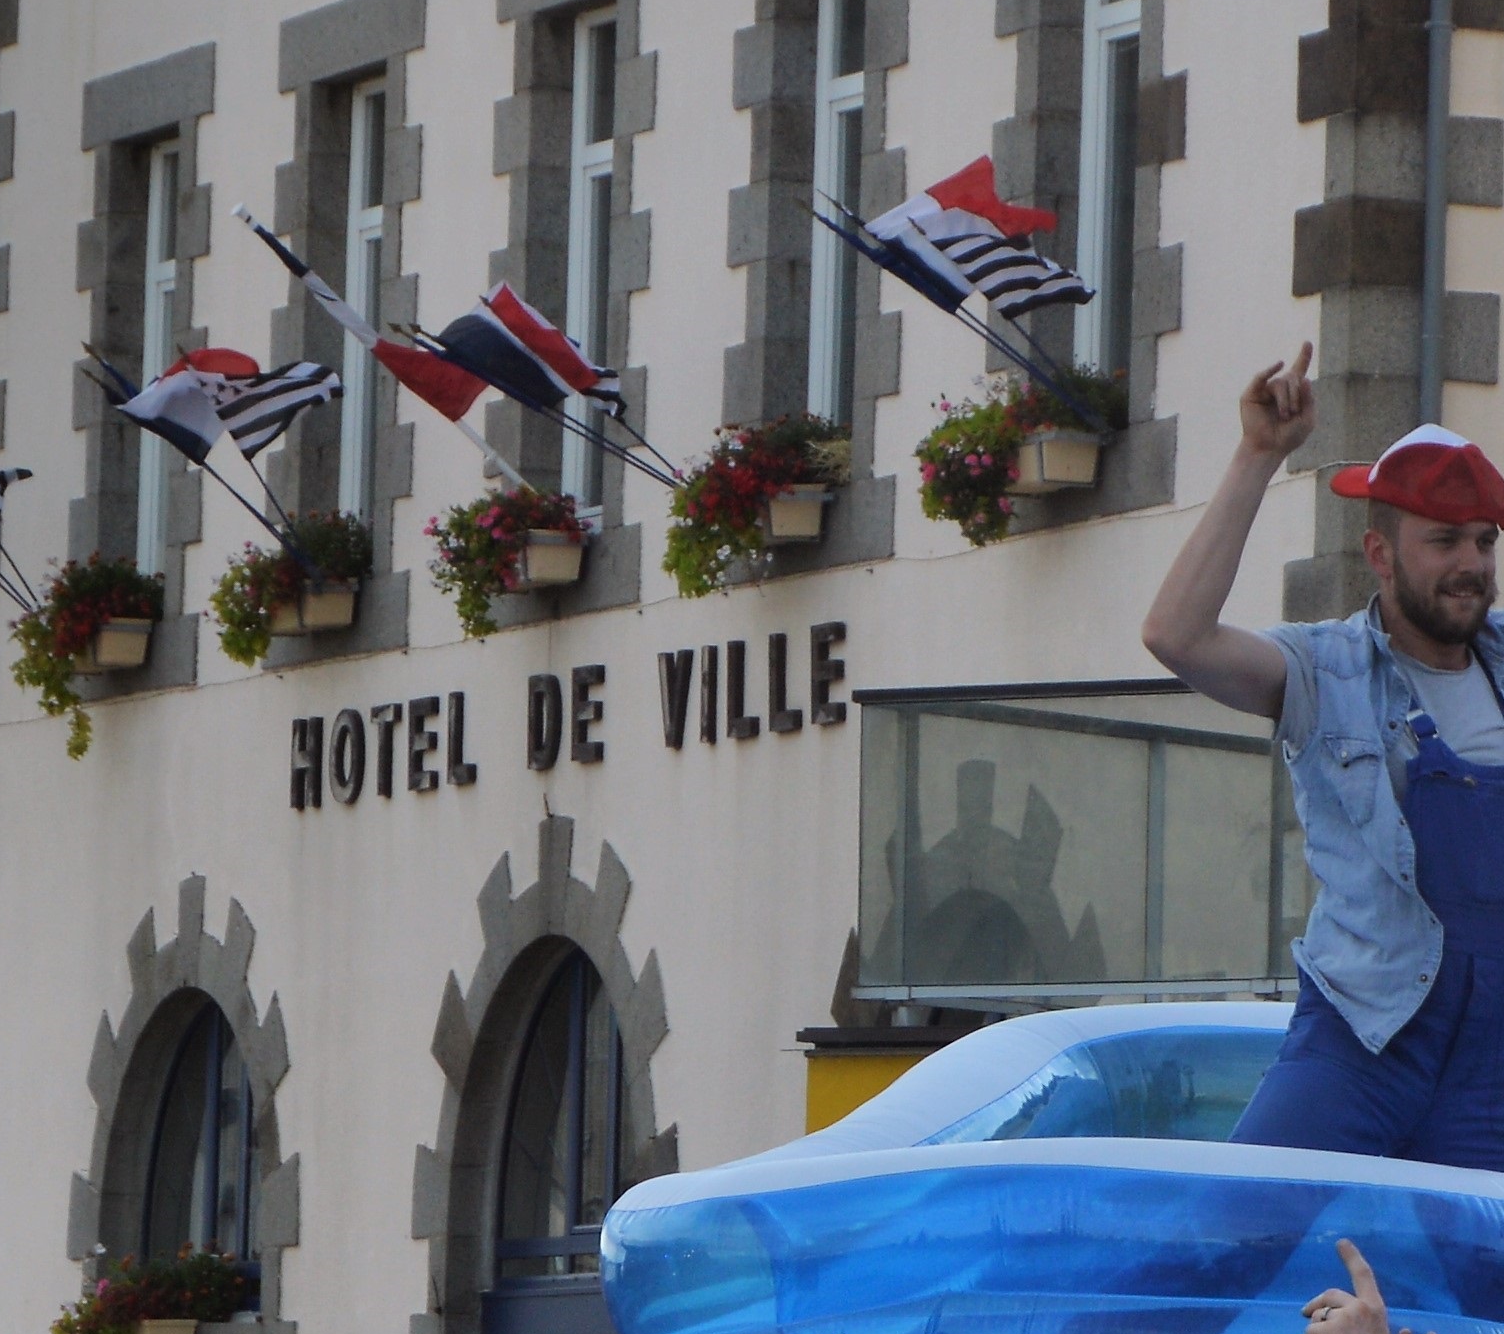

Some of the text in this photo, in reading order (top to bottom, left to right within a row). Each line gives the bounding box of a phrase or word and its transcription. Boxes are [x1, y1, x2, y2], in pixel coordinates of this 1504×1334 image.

[289, 621, 848, 811] HOTEL DE VILLE
